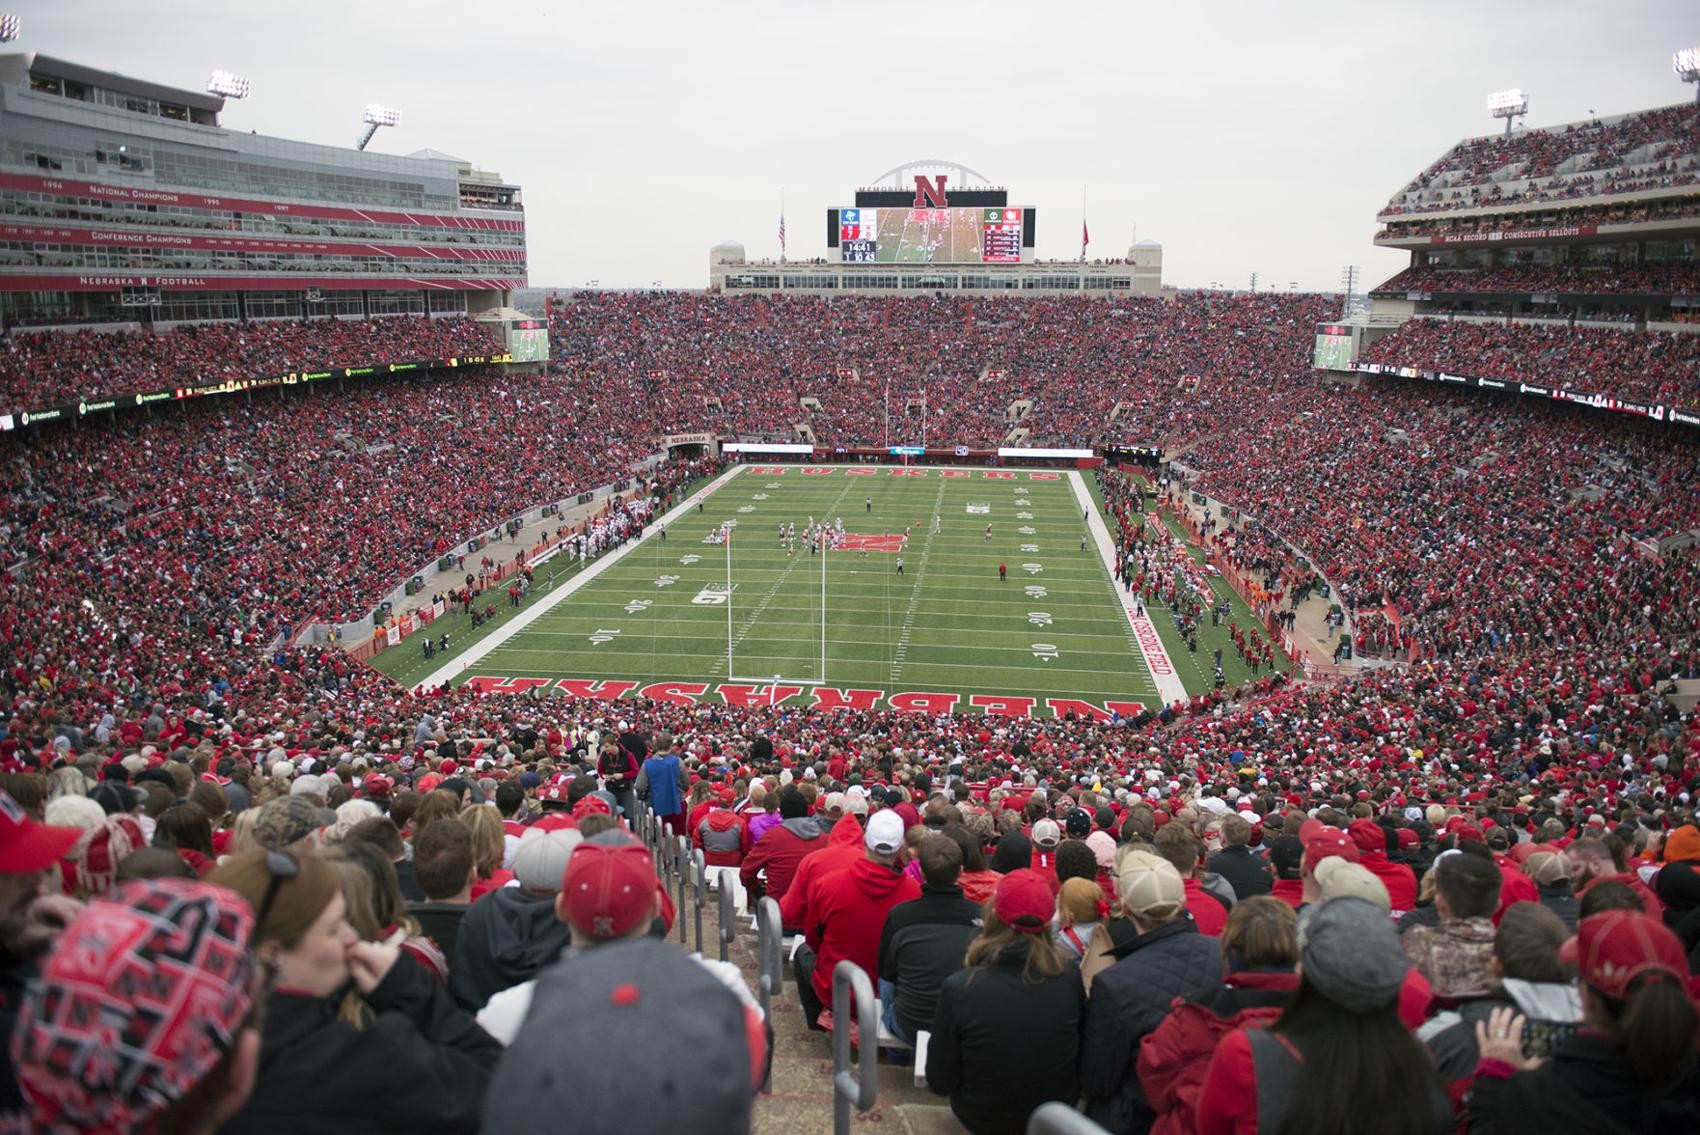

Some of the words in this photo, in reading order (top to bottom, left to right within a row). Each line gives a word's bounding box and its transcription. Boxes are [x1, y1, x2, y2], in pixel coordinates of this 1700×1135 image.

[90, 186, 129, 197] NATIONAL
[132, 190, 178, 202] CHAMPIONS
[914, 176, 948, 208] N
[92, 232, 143, 242] CONFERENCE
[146, 235, 192, 244] CHAMPIONS
[1504, 230, 1546, 240] CONSECUTIVE
[1549, 228, 1579, 236] SELLOUTS
[80, 276, 133, 285] NEBRASKA
[156, 278, 205, 286] FOOTBALL
[746, 467, 1061, 480] HUSKERS
[588, 628, 621, 642] 10
[1032, 644, 1059, 658] 10
[1147, 653, 1172, 675] FIELD
